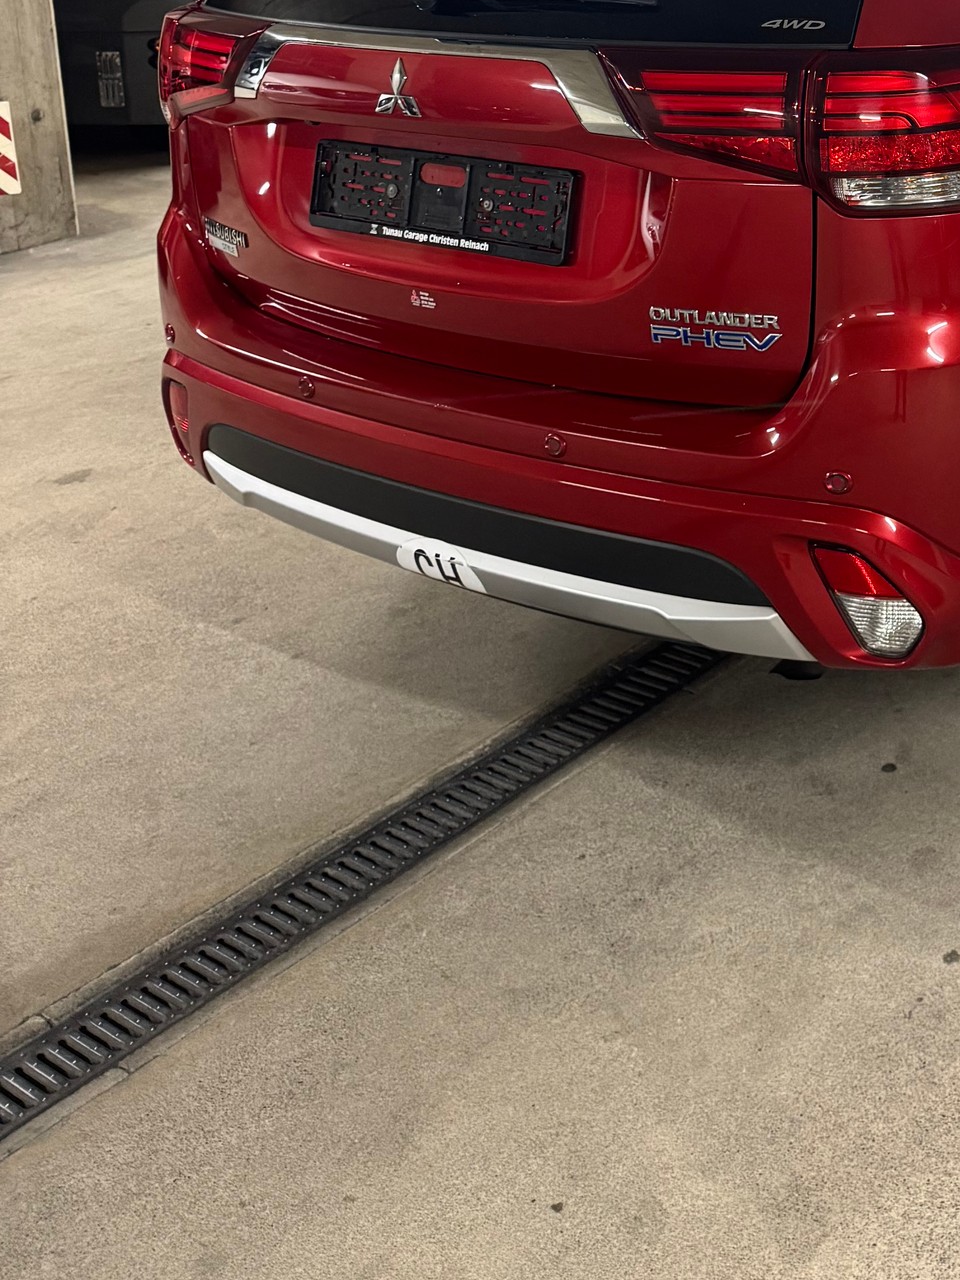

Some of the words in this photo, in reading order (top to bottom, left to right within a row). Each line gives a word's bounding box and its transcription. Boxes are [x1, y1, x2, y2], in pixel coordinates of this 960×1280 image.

[761, 19, 826, 30] 4WD
[382, 226, 403, 238] Tunau
[403, 229, 428, 242] Garage
[429, 233, 459, 247] Christen
[459, 239, 489, 252] Reinach
[649, 306, 781, 330] OUTLANDER
[650, 323, 783, 352] PHEV
[413, 548, 466, 587] CH
